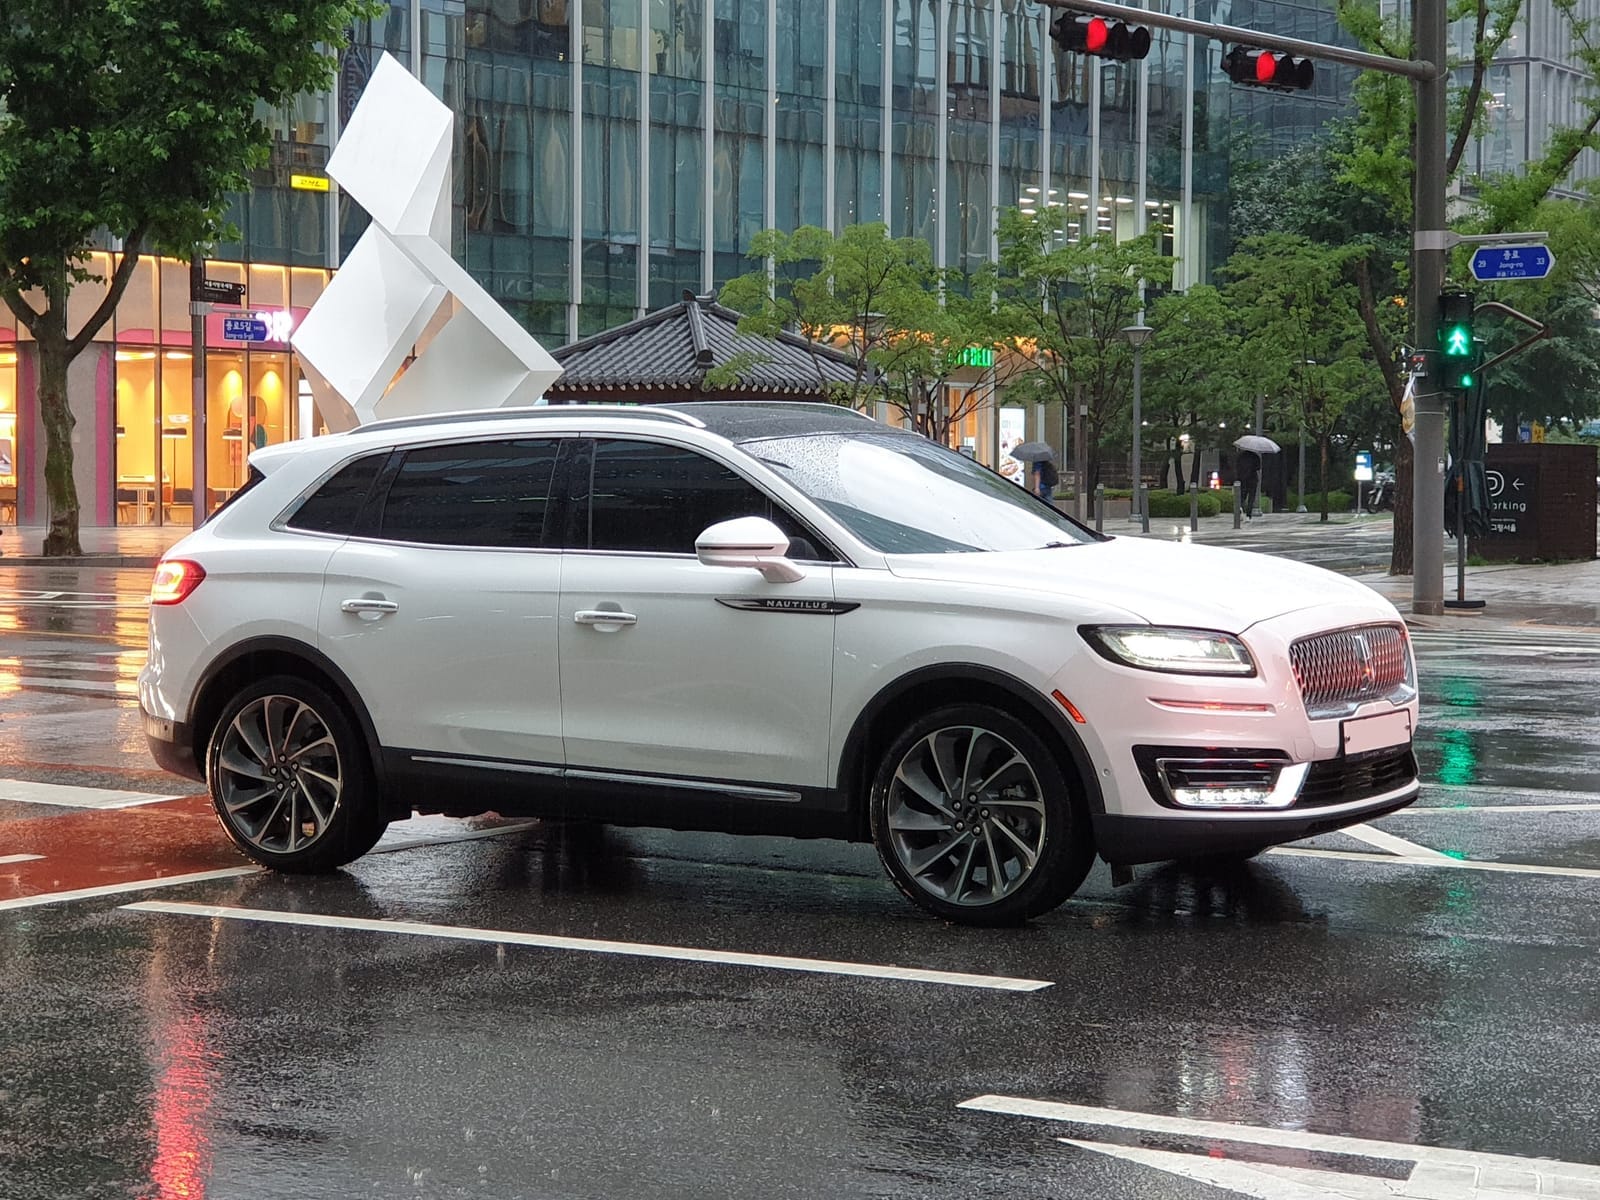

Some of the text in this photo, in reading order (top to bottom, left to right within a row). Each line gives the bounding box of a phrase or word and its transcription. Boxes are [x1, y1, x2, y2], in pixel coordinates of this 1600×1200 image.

[1503, 250, 1520, 260] 종로
[226, 320, 252, 332] 종로5길
[1494, 502, 1526, 512] arking
[766, 600, 828, 609] NAUTILUS
